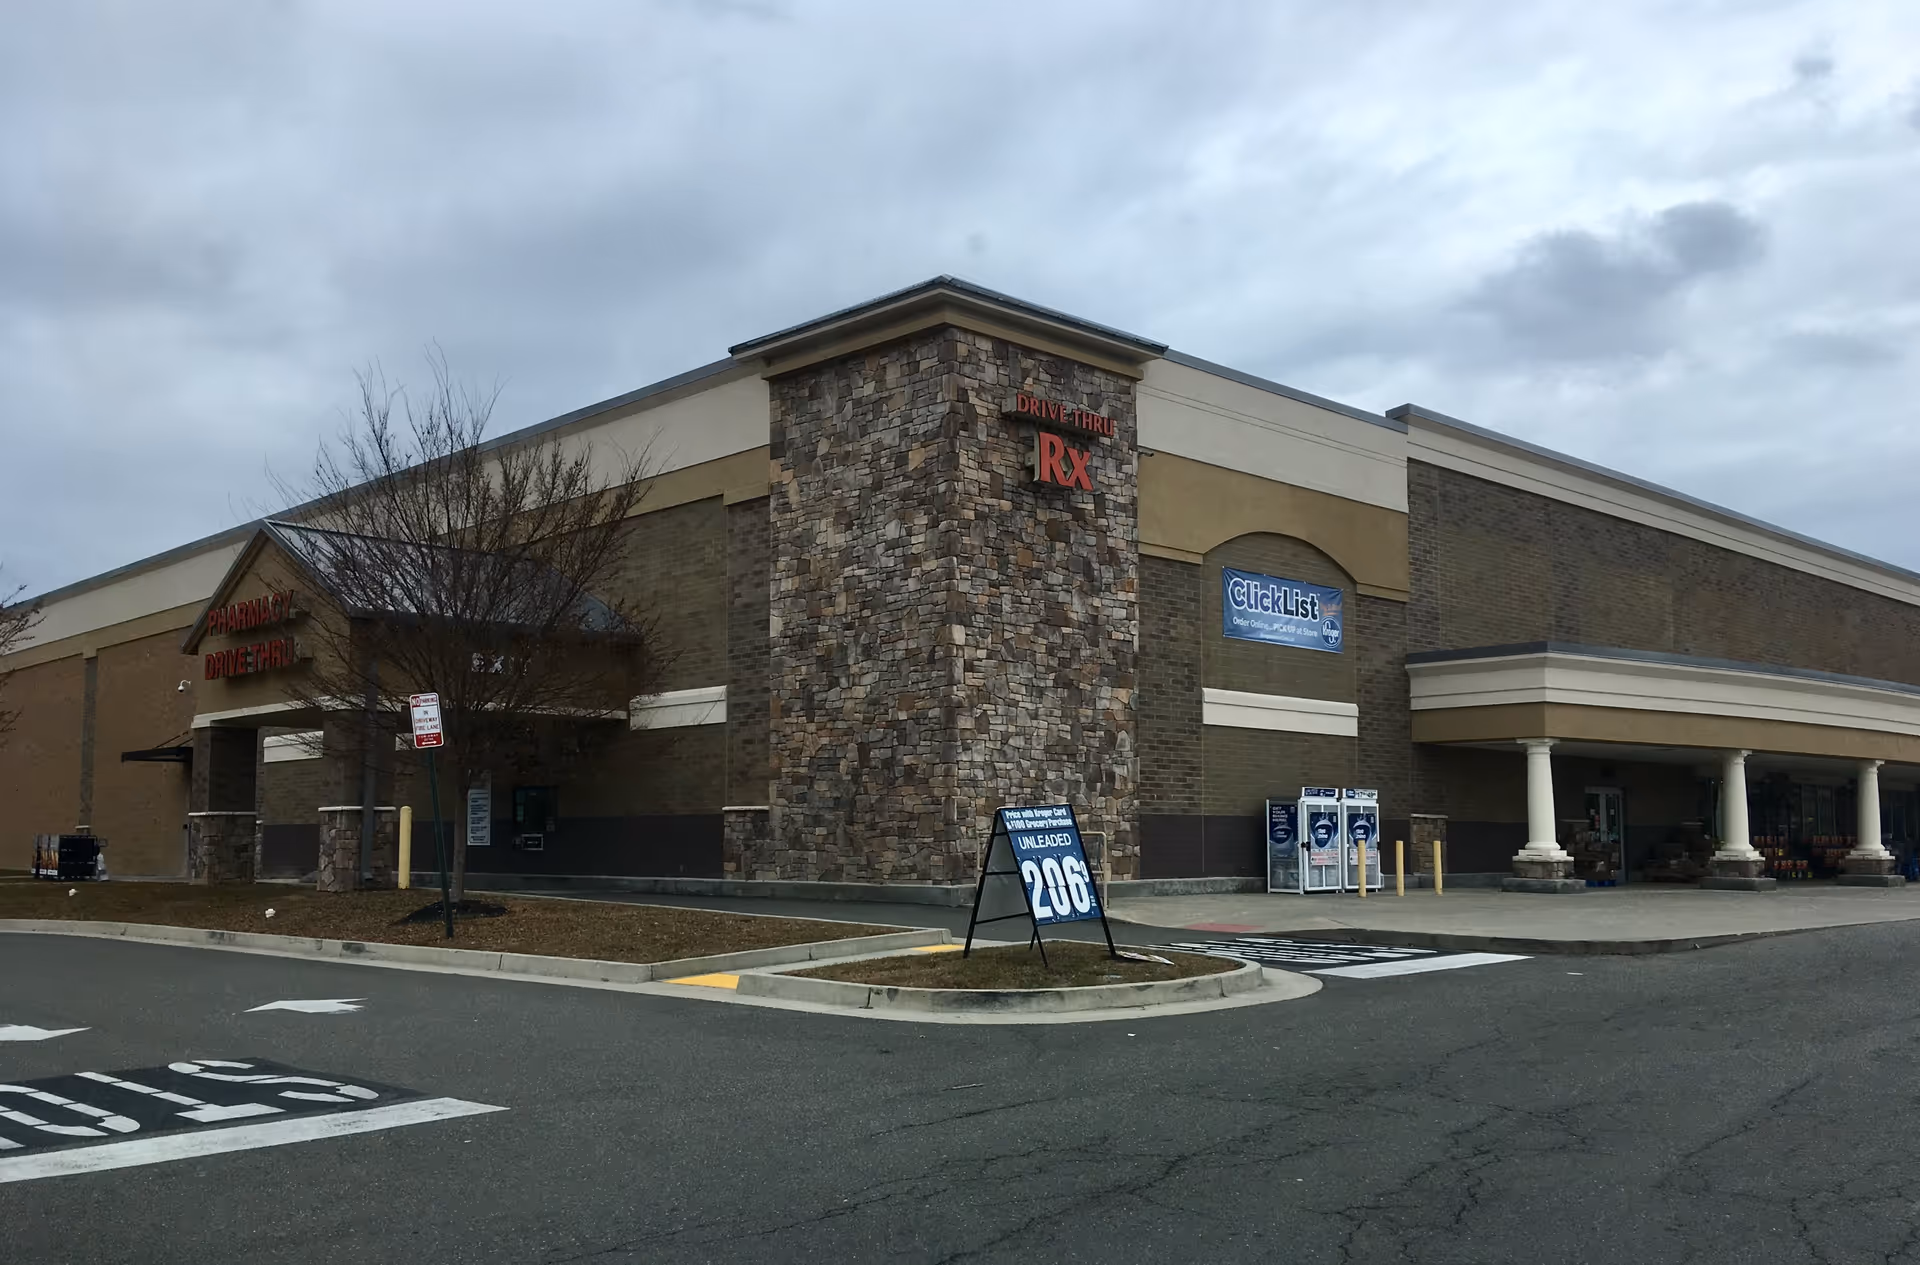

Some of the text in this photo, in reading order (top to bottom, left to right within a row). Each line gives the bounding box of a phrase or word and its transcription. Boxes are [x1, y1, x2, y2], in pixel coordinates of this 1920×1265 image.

[1017, 394, 1114, 436] DRIVE-THRU
[1036, 431, 1094, 491] Rx
[1229, 577, 1320, 623] ClickList
[208, 589, 294, 636] PHARMACY
[1232, 616, 1250, 627] Order
[1303, 627, 1318, 638] Store
[1322, 620, 1340, 644] Kroger
[411, 697, 421, 706] NO
[1005, 807, 1067, 819] Price with Kroger Card
[1025, 818, 1049, 829] Grocery
[1048, 817, 1073, 827] Purchase
[1018, 833, 1072, 850] UNLEADED
[0, 1059, 380, 1150] STO
